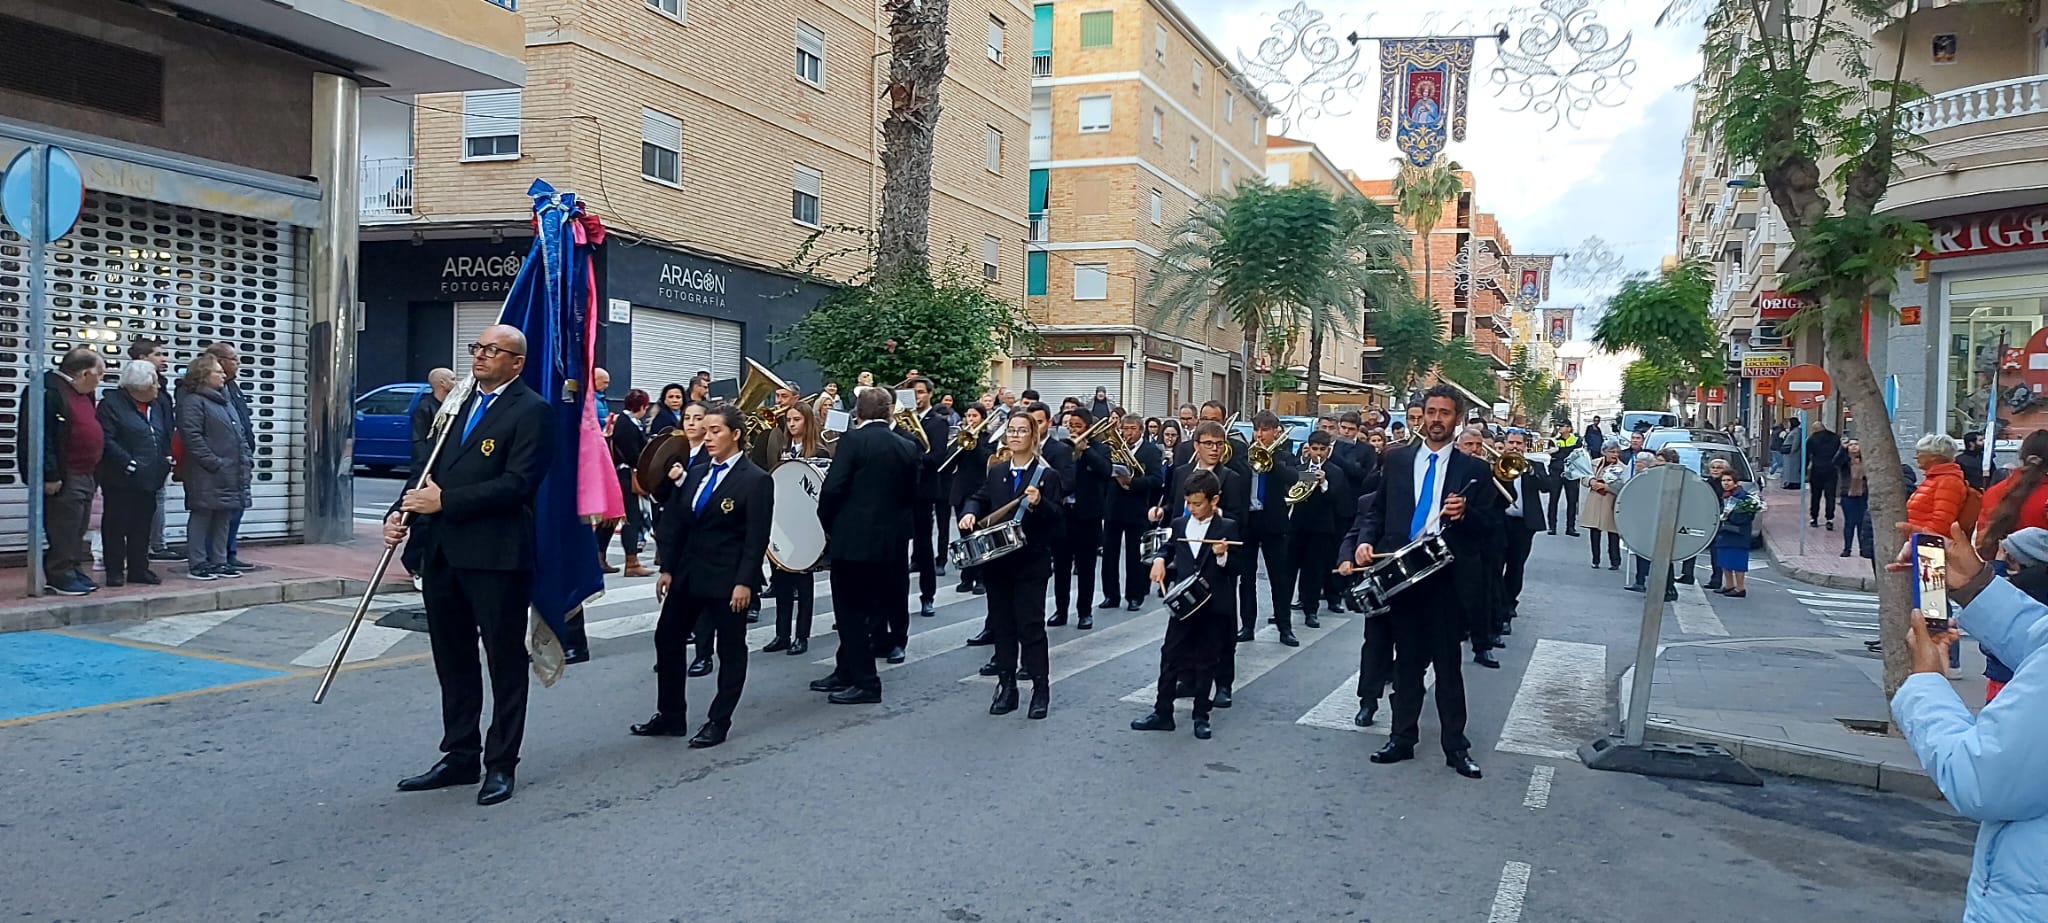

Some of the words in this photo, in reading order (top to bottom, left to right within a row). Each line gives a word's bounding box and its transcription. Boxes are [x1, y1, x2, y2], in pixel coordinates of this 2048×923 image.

[442, 251, 525, 277] ARAGÓ
[441, 282, 510, 292] FOTOGRA
[660, 263, 726, 294] ARAGÓN
[659, 287, 726, 308] FOTOGRAFÍA
